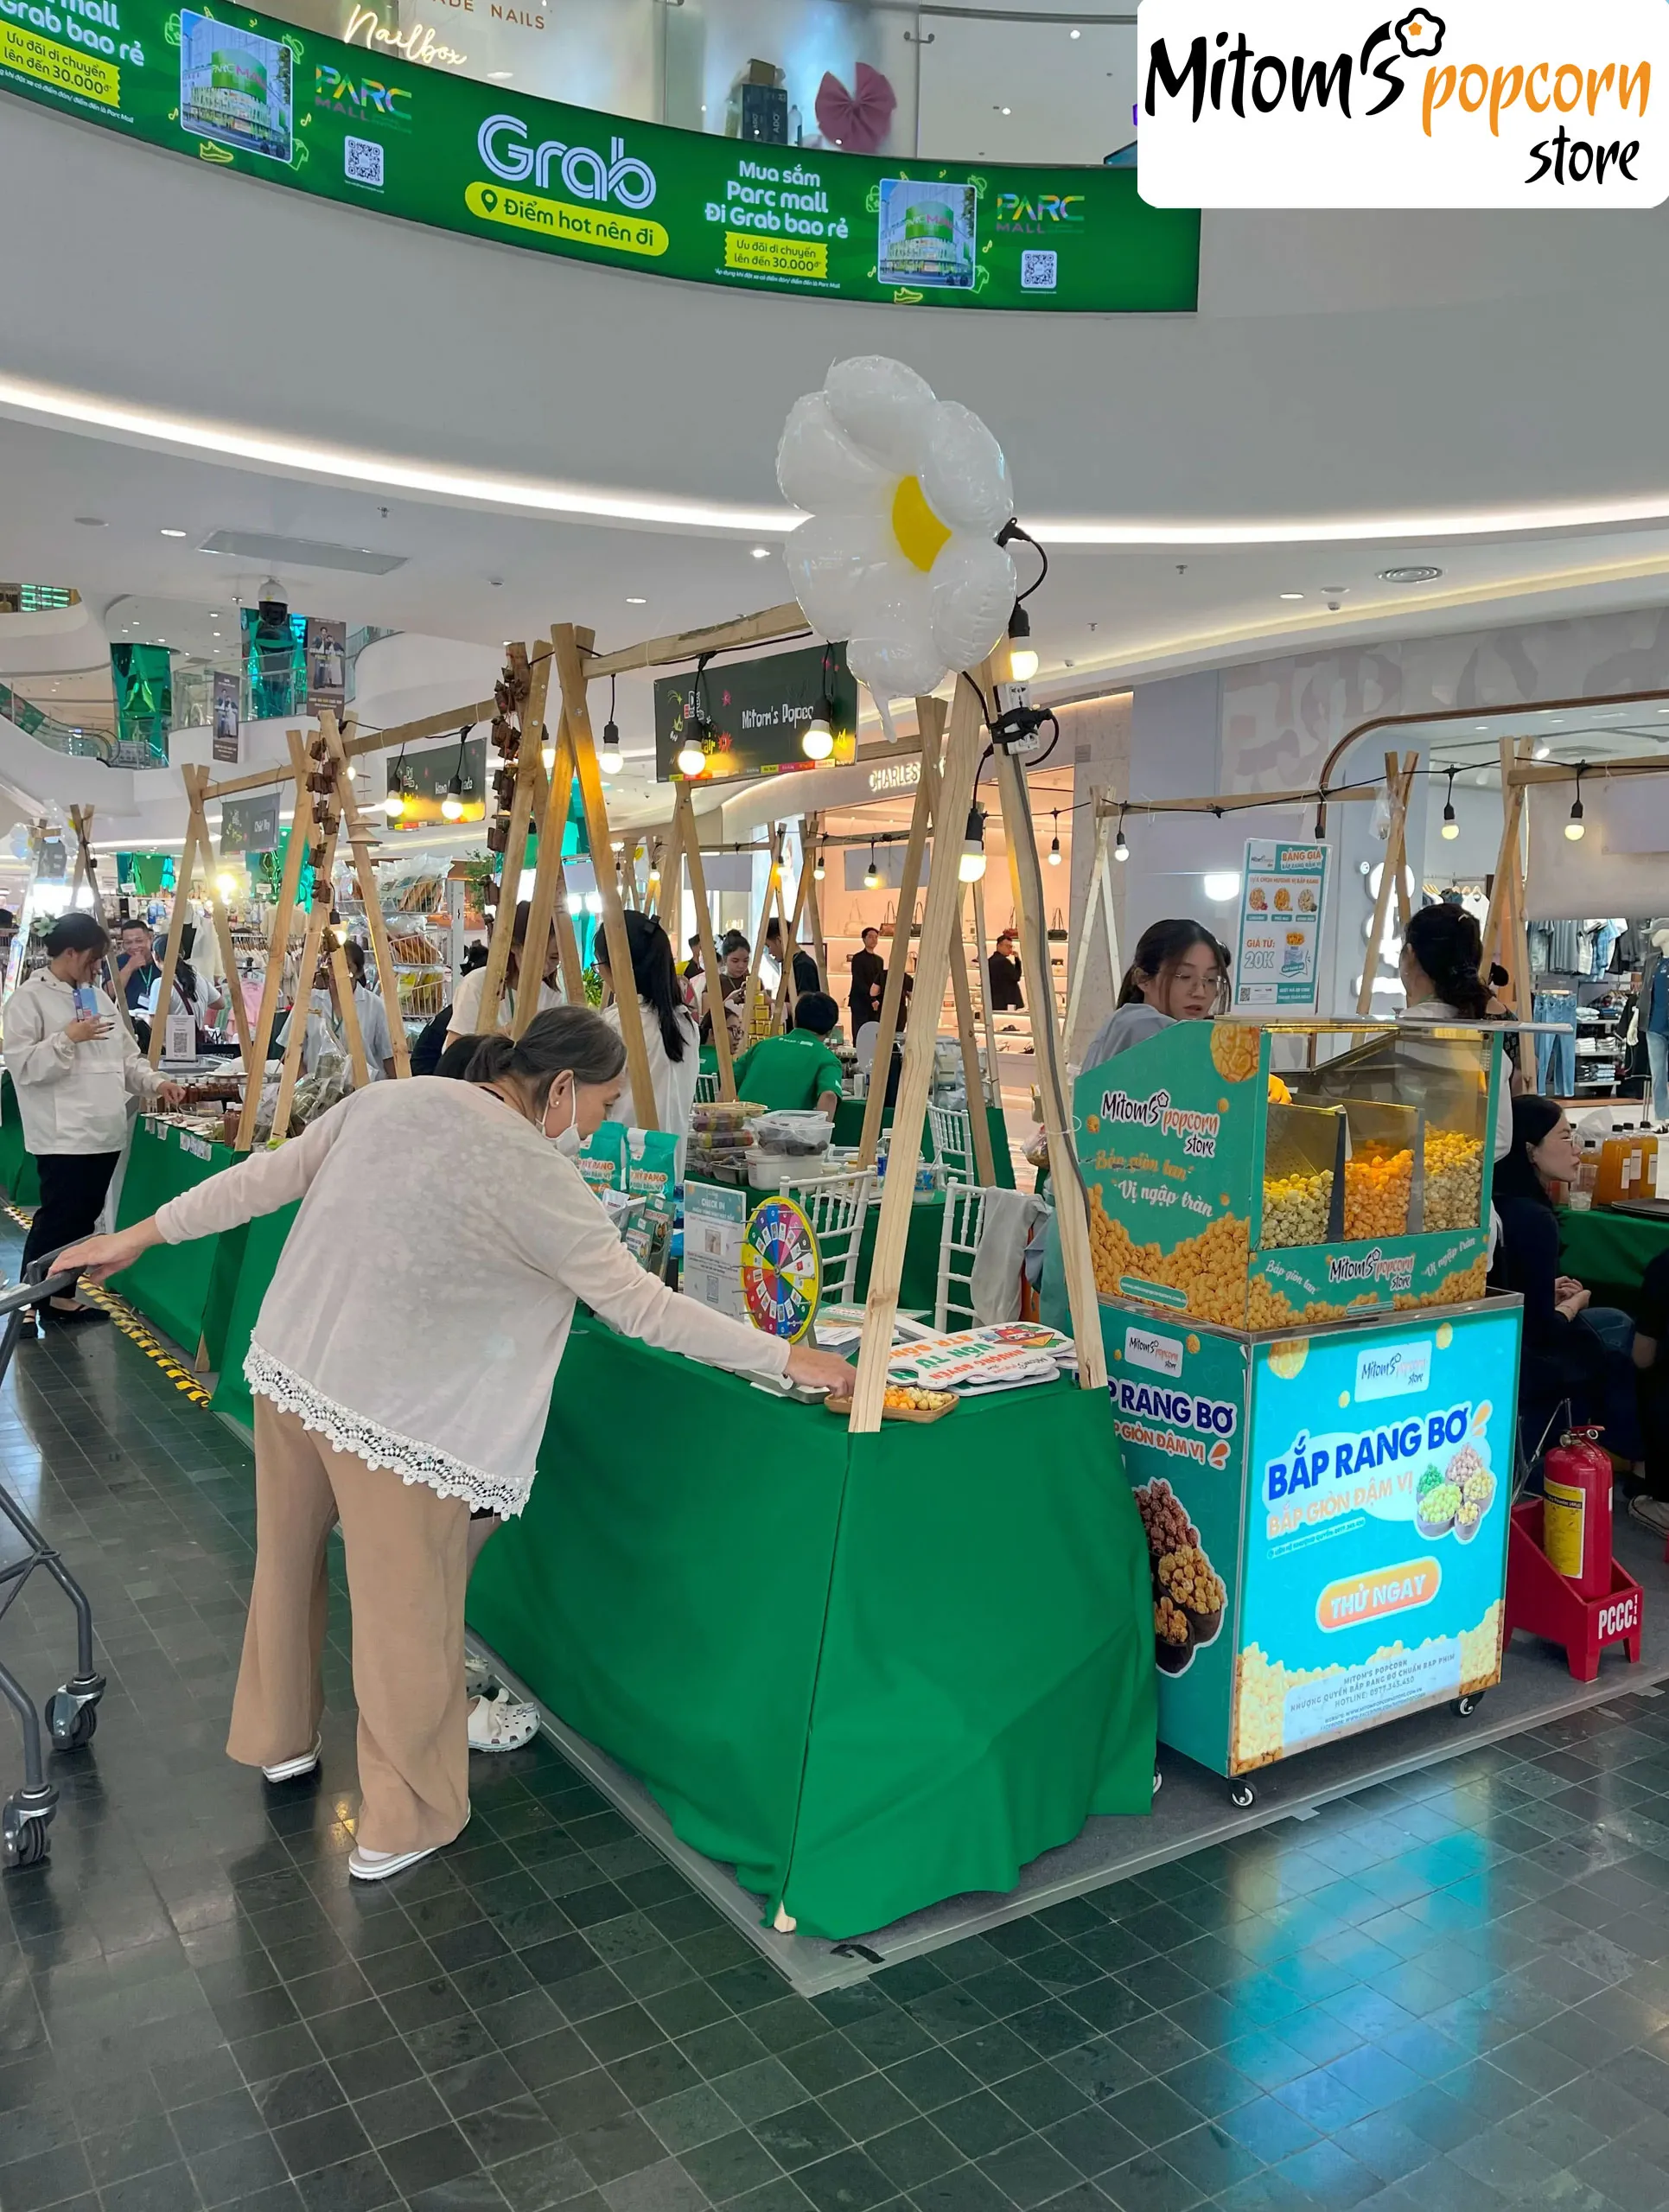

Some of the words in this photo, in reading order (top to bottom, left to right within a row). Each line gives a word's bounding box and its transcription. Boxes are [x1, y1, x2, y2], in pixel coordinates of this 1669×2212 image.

[491, 3, 545, 29] NAILS
[67, 15, 115, 54] bao
[119, 40, 144, 67] rẻ
[343, 4, 467, 65] Nailbox
[4, 46, 23, 65] lên
[26, 57, 50, 75] đến
[7, 31, 23, 47] Ưu
[26, 40, 46, 56] đãi
[62, 55, 105, 80] chuyển
[315, 64, 412, 120] PARC
[315, 95, 370, 122] MALL
[477, 114, 657, 209] Grab
[739, 160, 779, 182] Mua
[782, 163, 820, 188] sắm
[727, 180, 776, 207] Parc
[780, 191, 829, 214] mall
[997, 194, 1085, 221] PARC
[504, 200, 553, 227] Điểm
[559, 210, 591, 235] hot
[596, 218, 631, 243] nên
[636, 226, 653, 247] đi
[704, 202, 726, 223] Đi
[730, 207, 780, 231] Grab
[785, 213, 824, 236] bao
[827, 217, 849, 239] rẻ
[997, 223, 1045, 233] MALL
[734, 252, 749, 264] lên
[751, 255, 770, 266] đến
[752, 240, 768, 252] đãi
[742, 705, 779, 729] Mitom's
[869, 762, 921, 793] CHARLES
[1244, 951, 1275, 969] 20K
[1163, 1109, 1218, 1134] popcorn
[1185, 1133, 1214, 1155] store
[1118, 1180, 1137, 1203] Vị
[1141, 1184, 1179, 1207] ngập
[1182, 1192, 1214, 1217] tràn
[1376, 1257, 1415, 1281] popcorn
[1391, 1274, 1411, 1291] store
[1121, 1384, 1191, 1424] RANG
[1197, 1402, 1233, 1434] BƠ
[1123, 1424, 1154, 1444] GIÒN
[1156, 1431, 1188, 1455] ĐẬM
[1189, 1442, 1204, 1463] VỊ
[1268, 1436, 1330, 1501] BẮP
[1335, 1423, 1422, 1478] RANG
[1428, 1407, 1469, 1450] BƠ
[1269, 1502, 1303, 1536] BẮP
[1307, 1494, 1351, 1522] GIÒN
[1354, 1478, 1392, 1507] ĐẬM
[1397, 1471, 1414, 1495] VỊ
[1331, 1584, 1369, 1620] THỬ
[1373, 1574, 1427, 1608] NGAY
[1598, 1599, 1633, 1640] PCCC
[1344, 1669, 1373, 1685] MITOM'S
[1375, 1660, 1407, 1675] POPCORN
[1335, 1692, 1368, 1708] HOTLINE:
